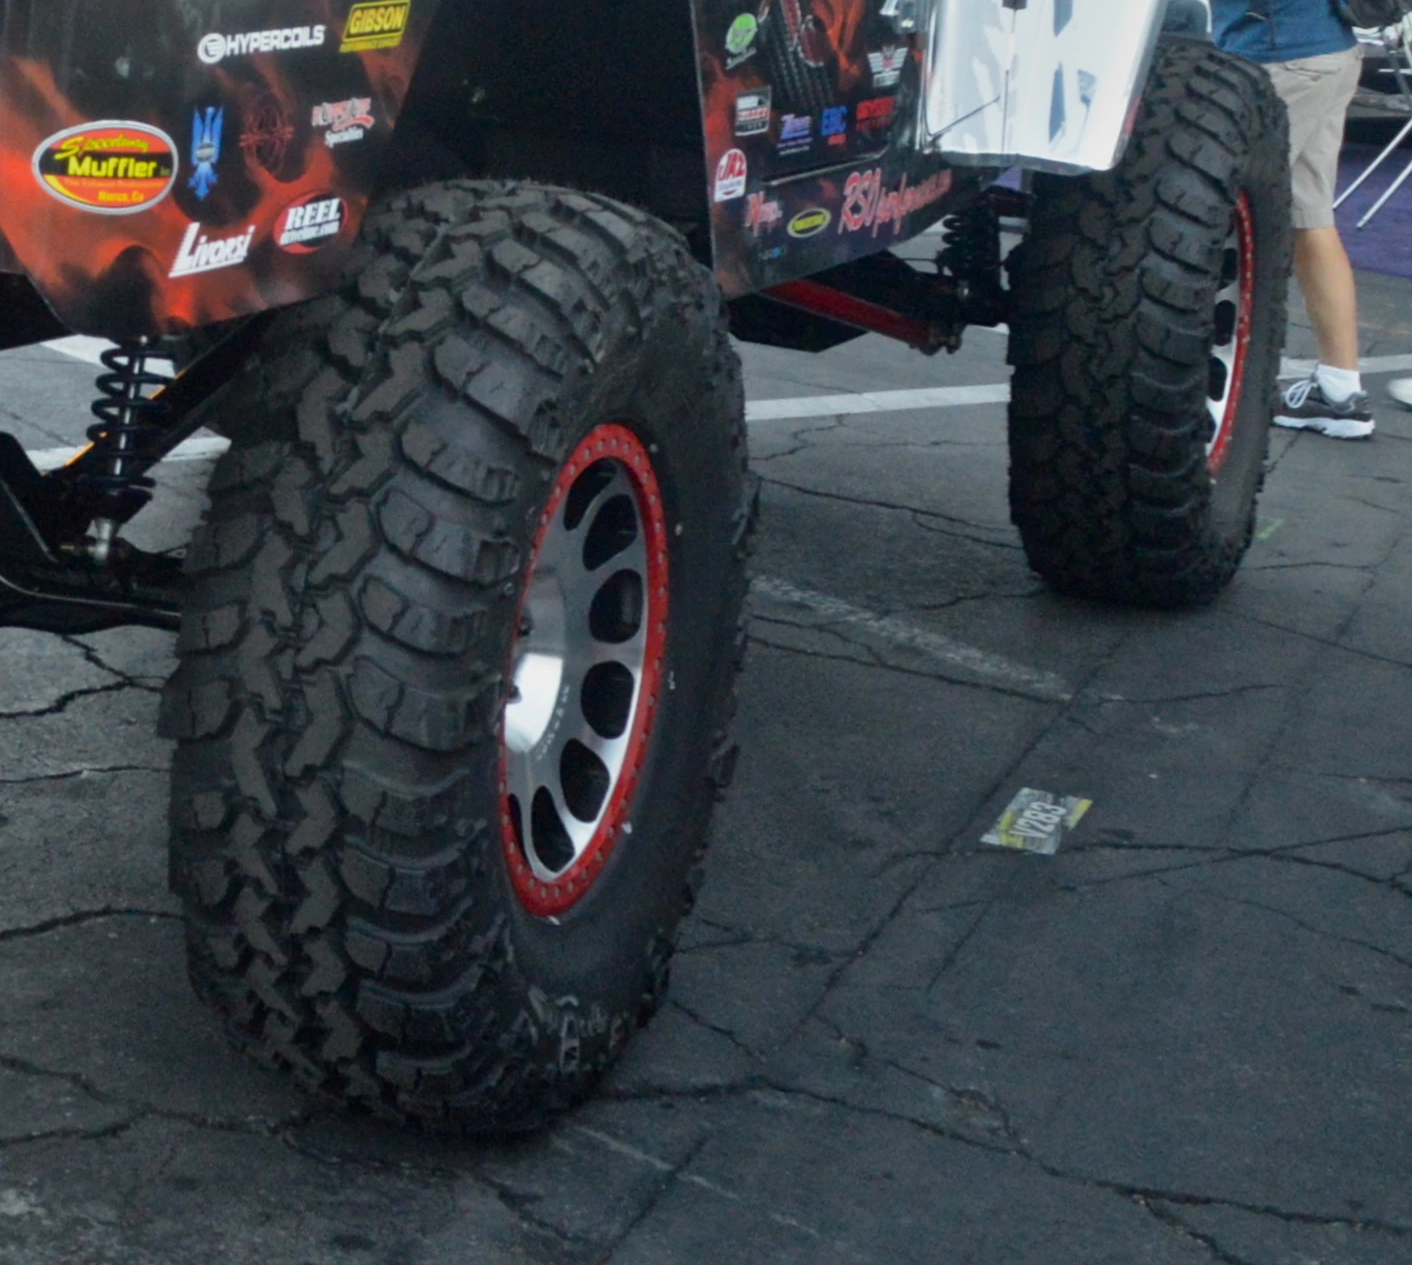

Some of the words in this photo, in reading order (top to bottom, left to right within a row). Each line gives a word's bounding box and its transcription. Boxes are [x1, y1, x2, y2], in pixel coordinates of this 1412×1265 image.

[349, 5, 407, 35] GIBSON
[226, 24, 327, 57] HYPERCOILS
[54, 134, 150, 162] Speedway
[67, 155, 157, 178] Muffler
[285, 197, 341, 231] REEL
